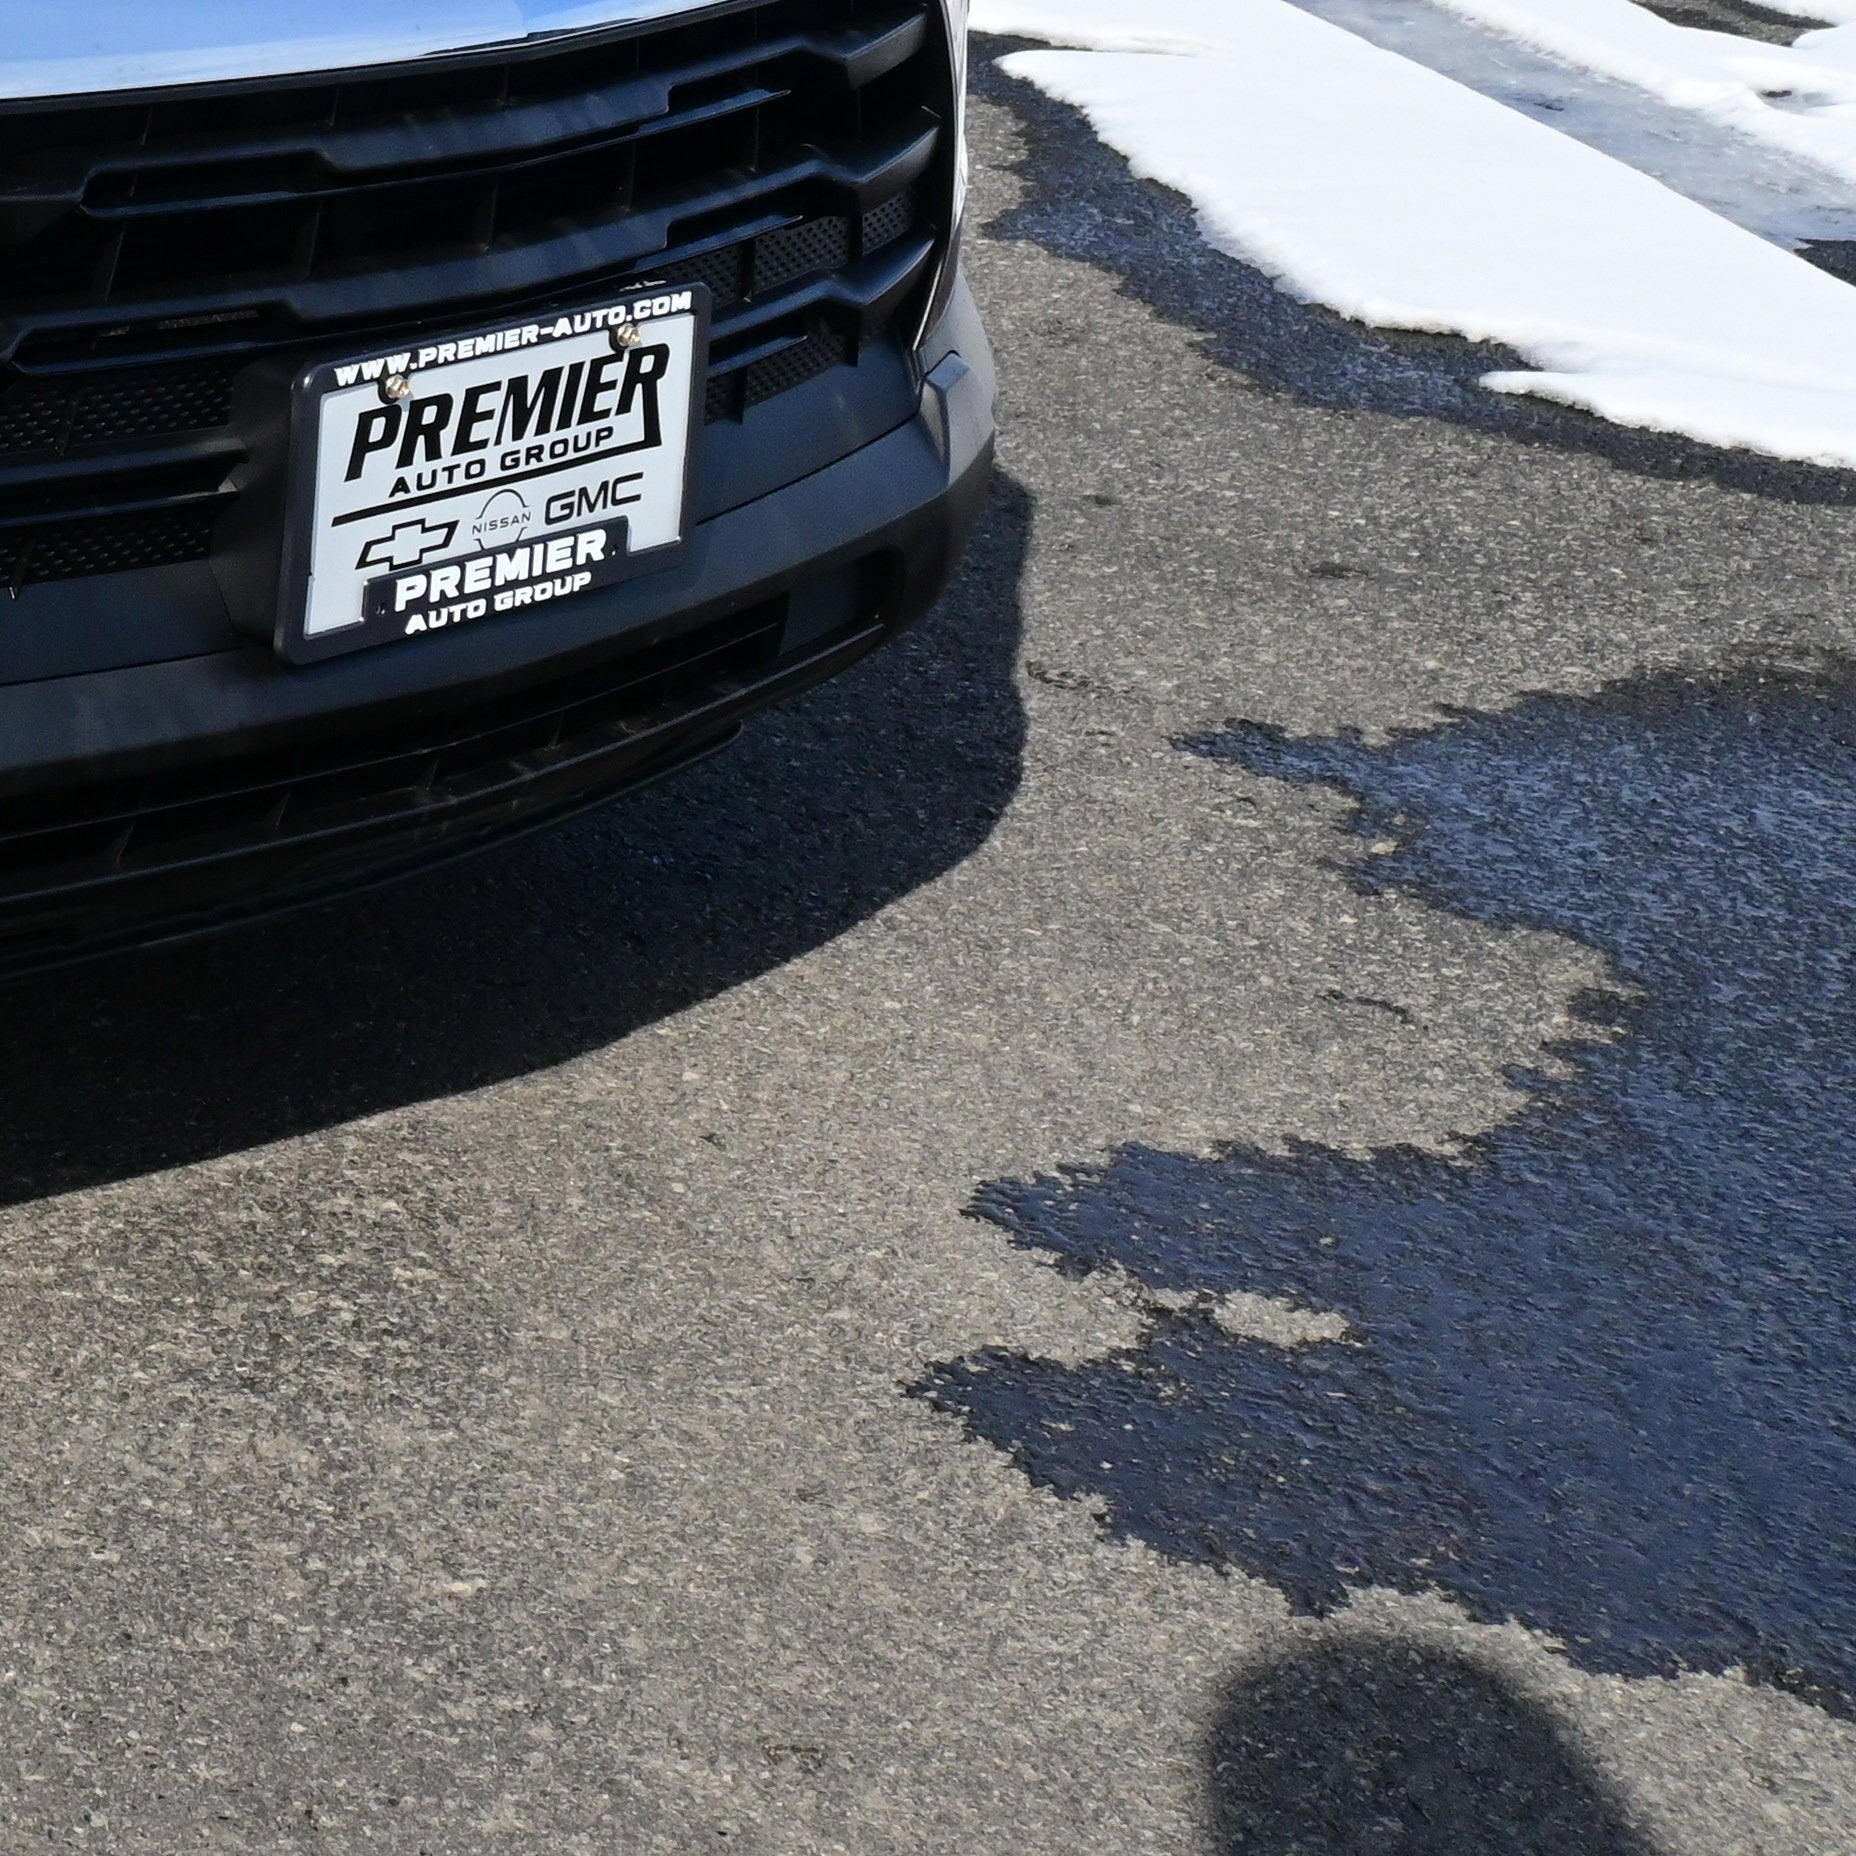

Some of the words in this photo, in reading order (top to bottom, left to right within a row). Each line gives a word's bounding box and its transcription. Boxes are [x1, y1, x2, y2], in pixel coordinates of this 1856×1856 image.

[334, 291, 692, 387] WWW.PREMIER-AUTO.COM
[344, 342, 670, 482] PREMIER
[389, 458, 486, 498] AUTO
[499, 425, 614, 471] GROUP
[471, 511, 532, 535] NISSAN
[544, 471, 644, 526] GMC
[394, 528, 608, 613] PREMIER
[404, 597, 487, 635] AUTO
[493, 571, 592, 612] GROUP
